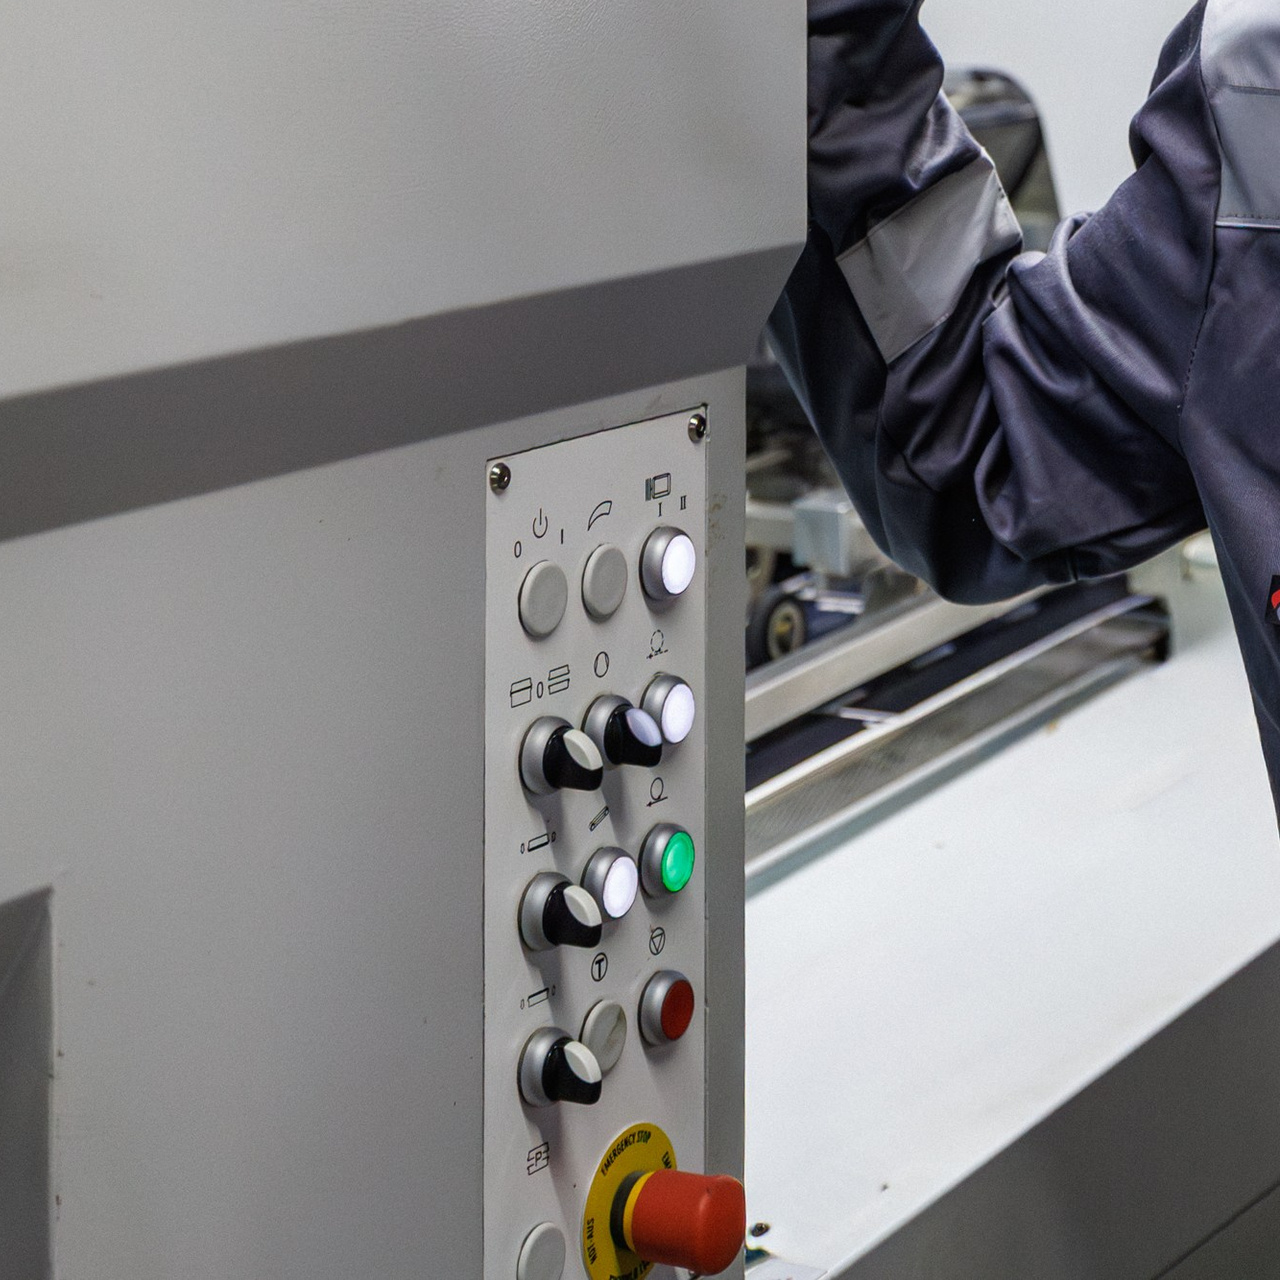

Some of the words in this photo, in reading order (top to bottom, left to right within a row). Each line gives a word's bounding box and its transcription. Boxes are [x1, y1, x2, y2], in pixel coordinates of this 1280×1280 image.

[601, 1132, 637, 1176] EMERGENCY
[636, 1130, 651, 1144] STOP
[587, 1218, 598, 1265] NOT-AUS
